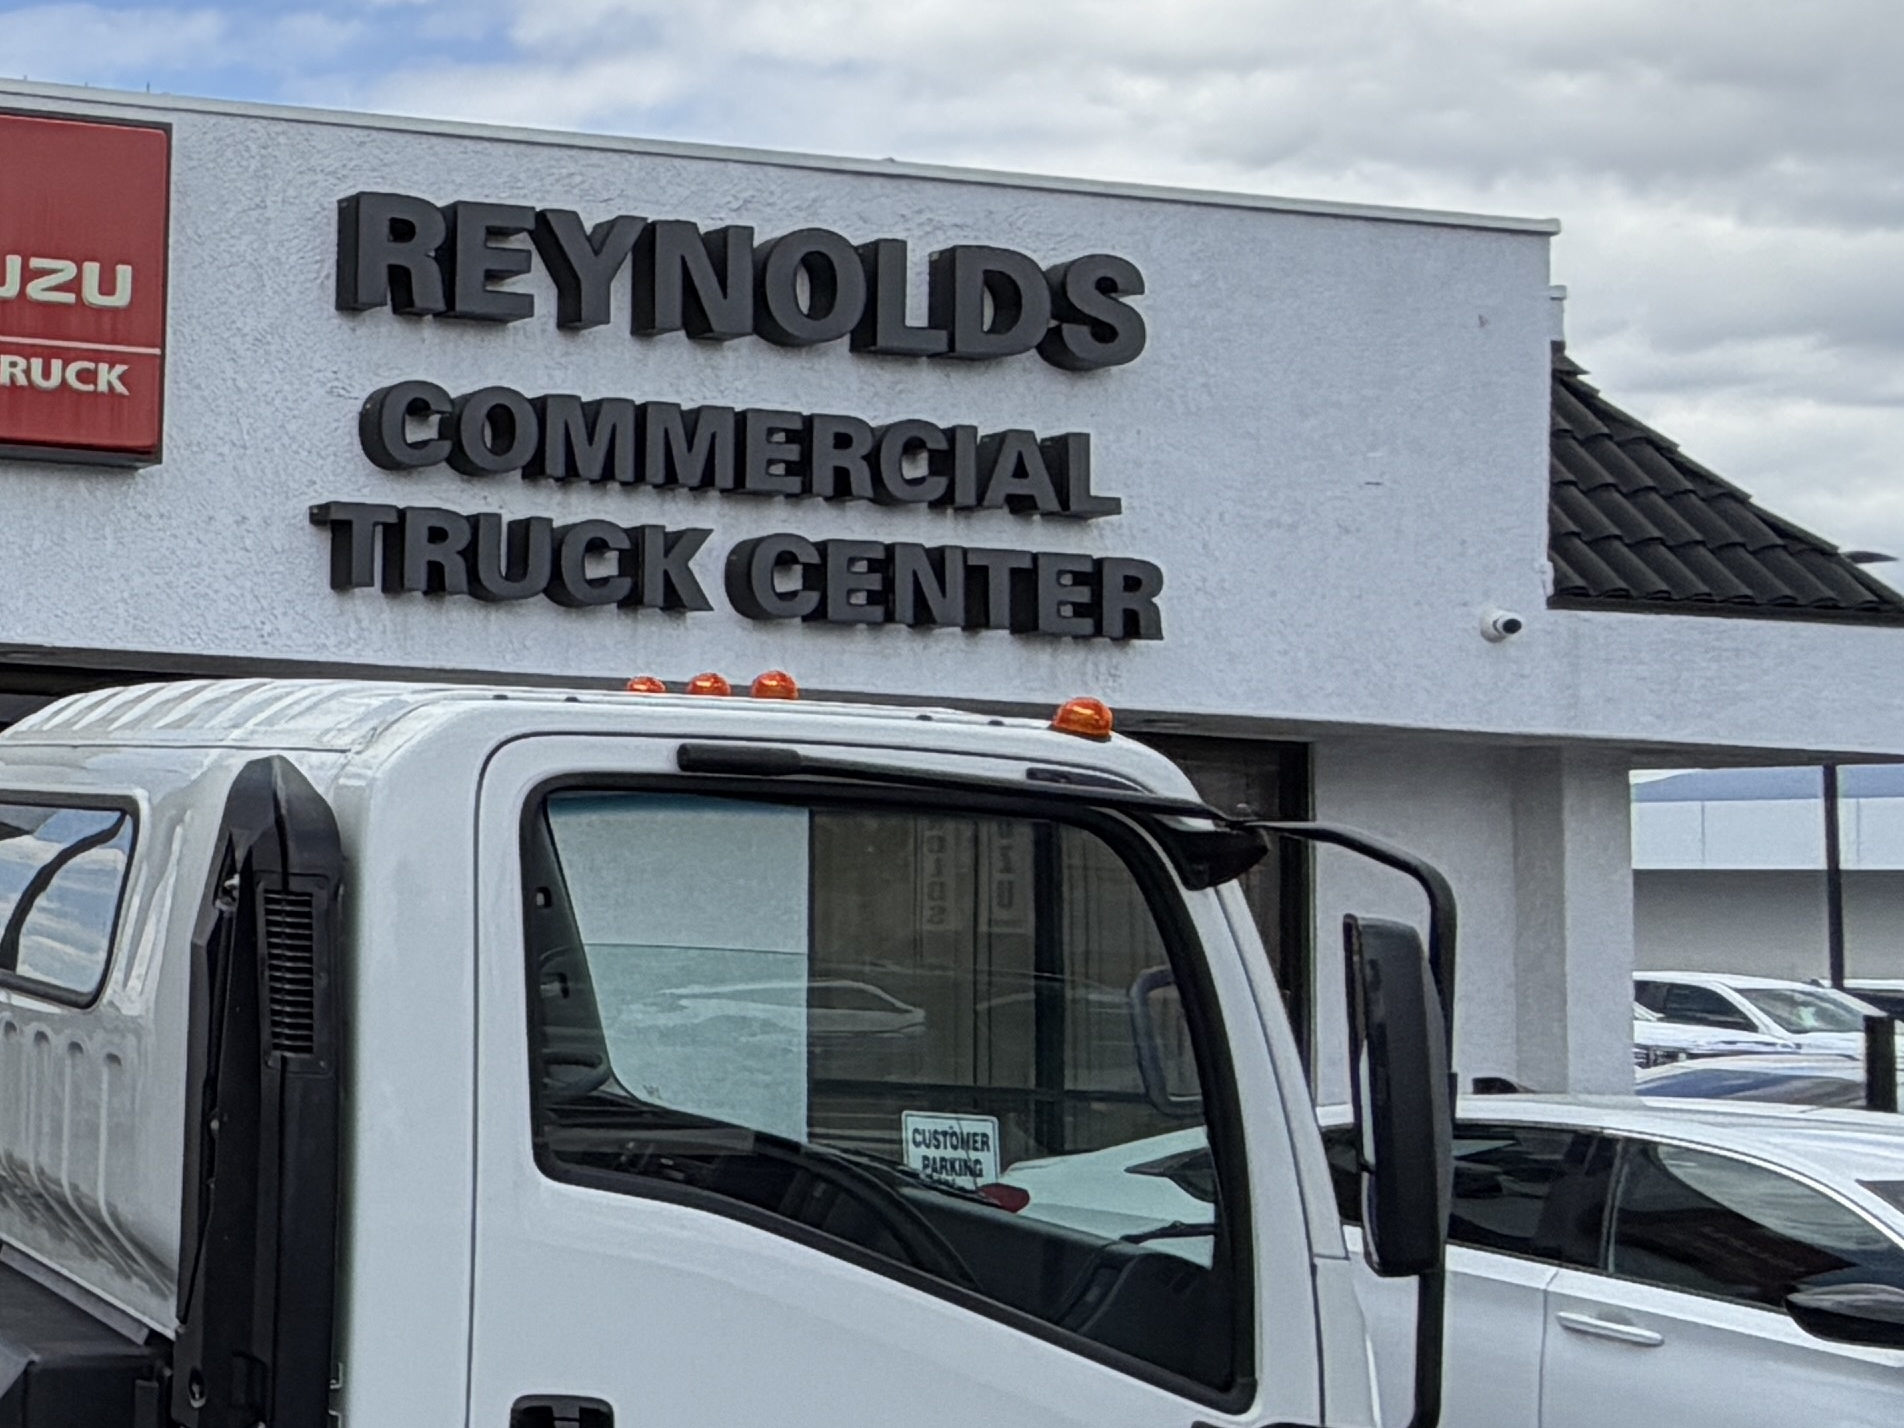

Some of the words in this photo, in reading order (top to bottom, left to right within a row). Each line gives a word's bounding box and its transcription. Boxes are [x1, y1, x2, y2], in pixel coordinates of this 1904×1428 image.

[336, 192, 1145, 371] REYNOLDS
[358, 380, 1122, 518] COMMERCIAL
[309, 501, 714, 611] TRUCK
[724, 533, 1164, 640] CENTER
[912, 1127, 991, 1153] CUSTOMER
[921, 1154, 984, 1178] PARKING
